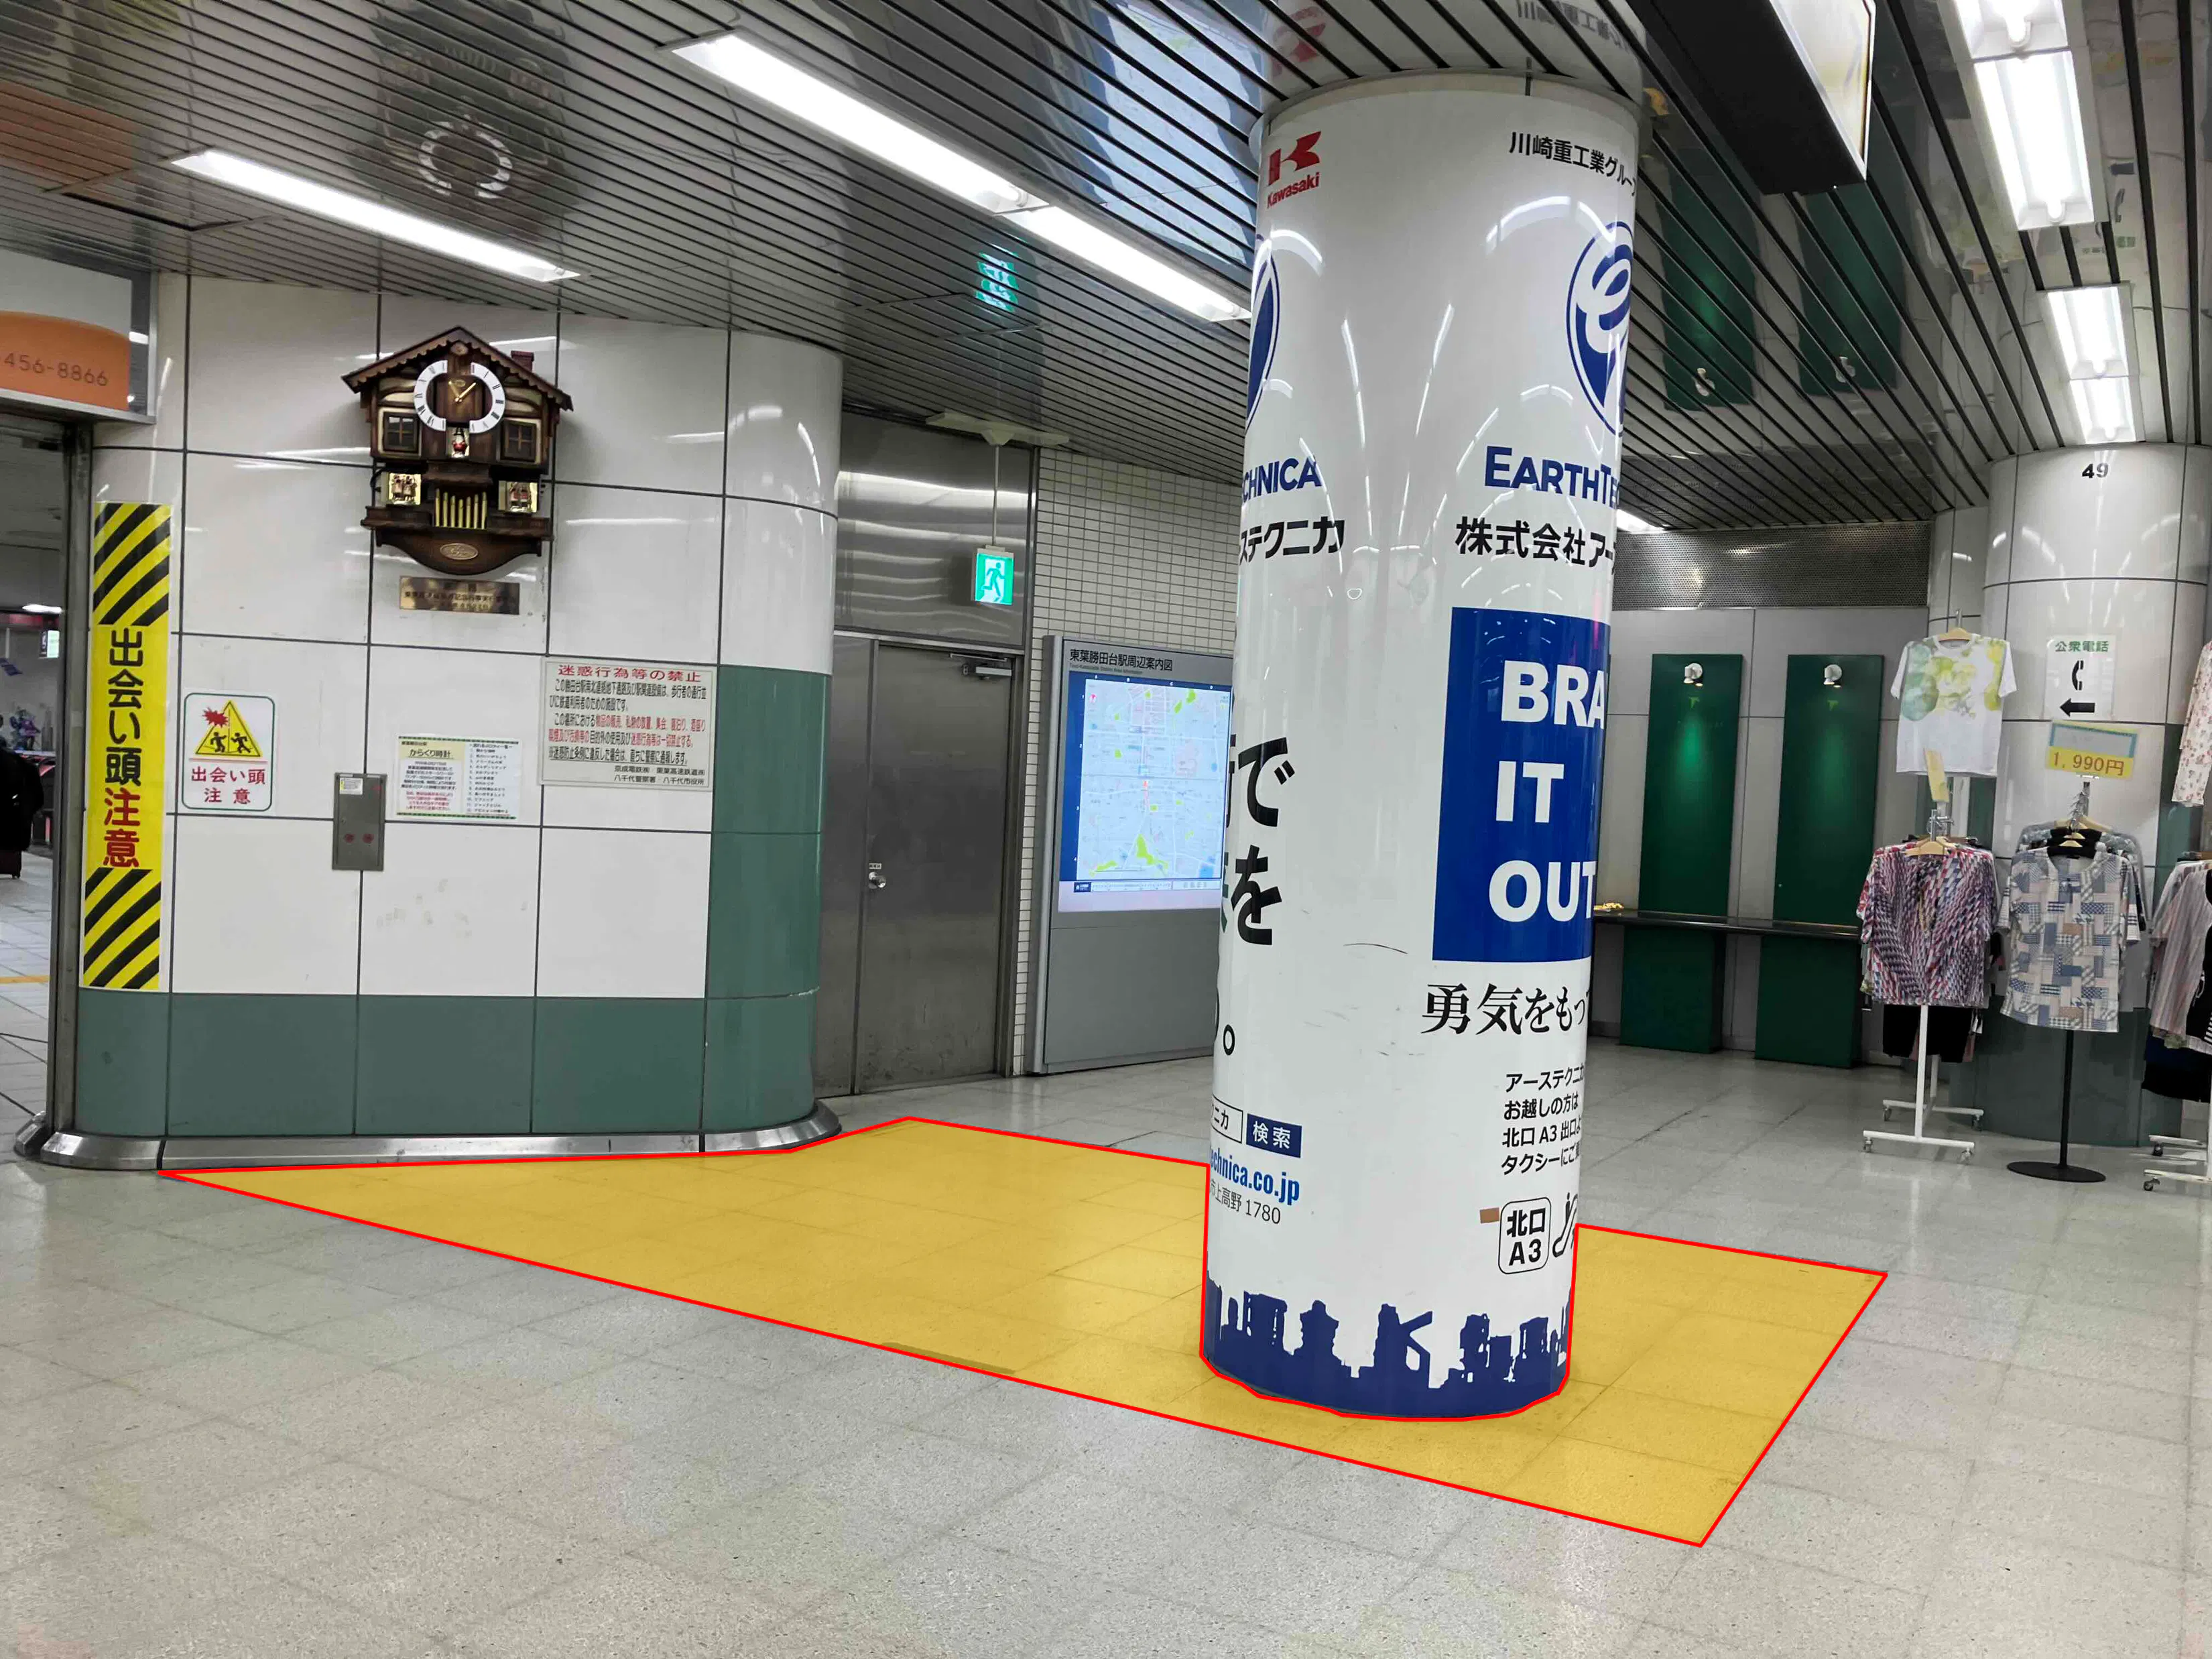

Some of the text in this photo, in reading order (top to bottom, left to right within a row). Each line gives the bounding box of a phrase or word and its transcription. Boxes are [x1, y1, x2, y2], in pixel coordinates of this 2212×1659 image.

[1509, 131, 1637, 196] 川崎重工業グルー
[1267, 172, 1320, 208] Kawasaki
[5, 352, 109, 387] 456-8866
[1485, 445, 1619, 509] EARTHTE
[2082, 463, 2109, 479] 49
[1239, 516, 1345, 564] ステクニカ
[1455, 515, 1616, 571] 株式会社アー
[1069, 649, 1173, 671] 東葉勝田台駅周辺案内図
[2054, 640, 2109, 652] 公衆電話
[558, 664, 701, 682] 迷惑行為等の禁止
[104, 627, 143, 868] 出会い頭注意
[410, 748, 451, 758] からくり時計
[192, 766, 265, 786] 出会い頭
[204, 787, 251, 805] 注意
[1495, 760, 1564, 823] IT
[1488, 860, 1594, 923] OUT
[1420, 983, 1593, 1036] 勇気をもっ
[1212, 1104, 1229, 1131] ニカ
[1503, 1092, 1579, 1121] お越しの方は
[1252, 1120, 1291, 1150] 検索
[1502, 1127, 1536, 1148] 北口
[1539, 1125, 1557, 1144] A3
[1245, 1199, 1281, 1225] 1780
[1506, 1207, 1546, 1238] 北口
[1508, 1240, 1542, 1267] A3
